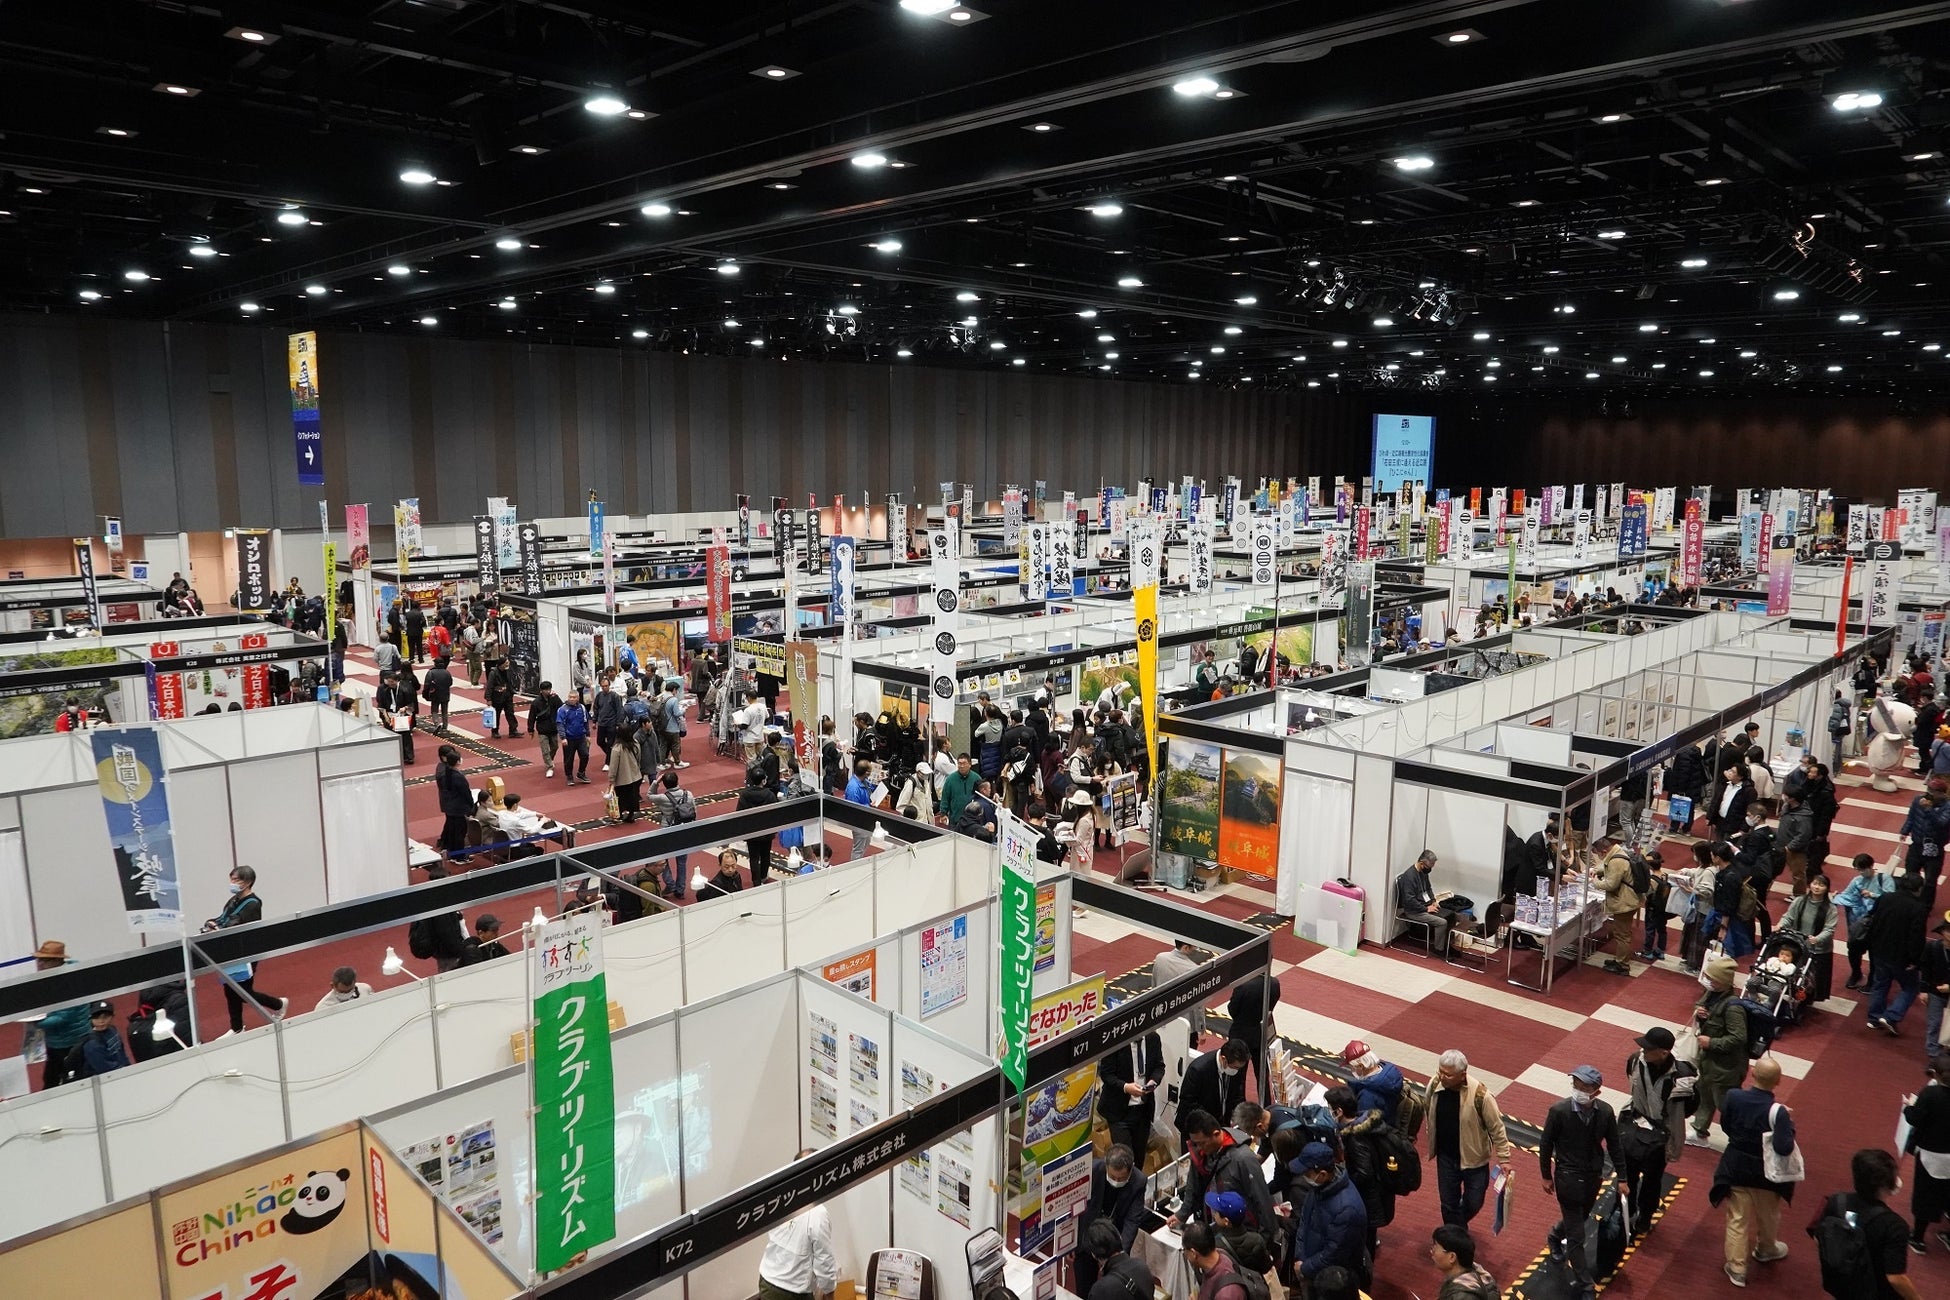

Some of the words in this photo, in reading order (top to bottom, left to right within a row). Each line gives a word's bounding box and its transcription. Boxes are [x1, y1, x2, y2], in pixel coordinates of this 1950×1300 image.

[245, 537, 264, 608] オシロボッツ
[1169, 825, 1213, 847] 岐阜城
[1169, 974, 1221, 1010] shachihata
[1073, 1041, 1090, 1058] K71
[557, 996, 590, 1248] クラブツーリズム
[244, 1173, 295, 1200] ニーハオ
[202, 1187, 297, 1235] Nihao
[176, 1217, 276, 1267] China
[664, 1239, 694, 1264] K72
